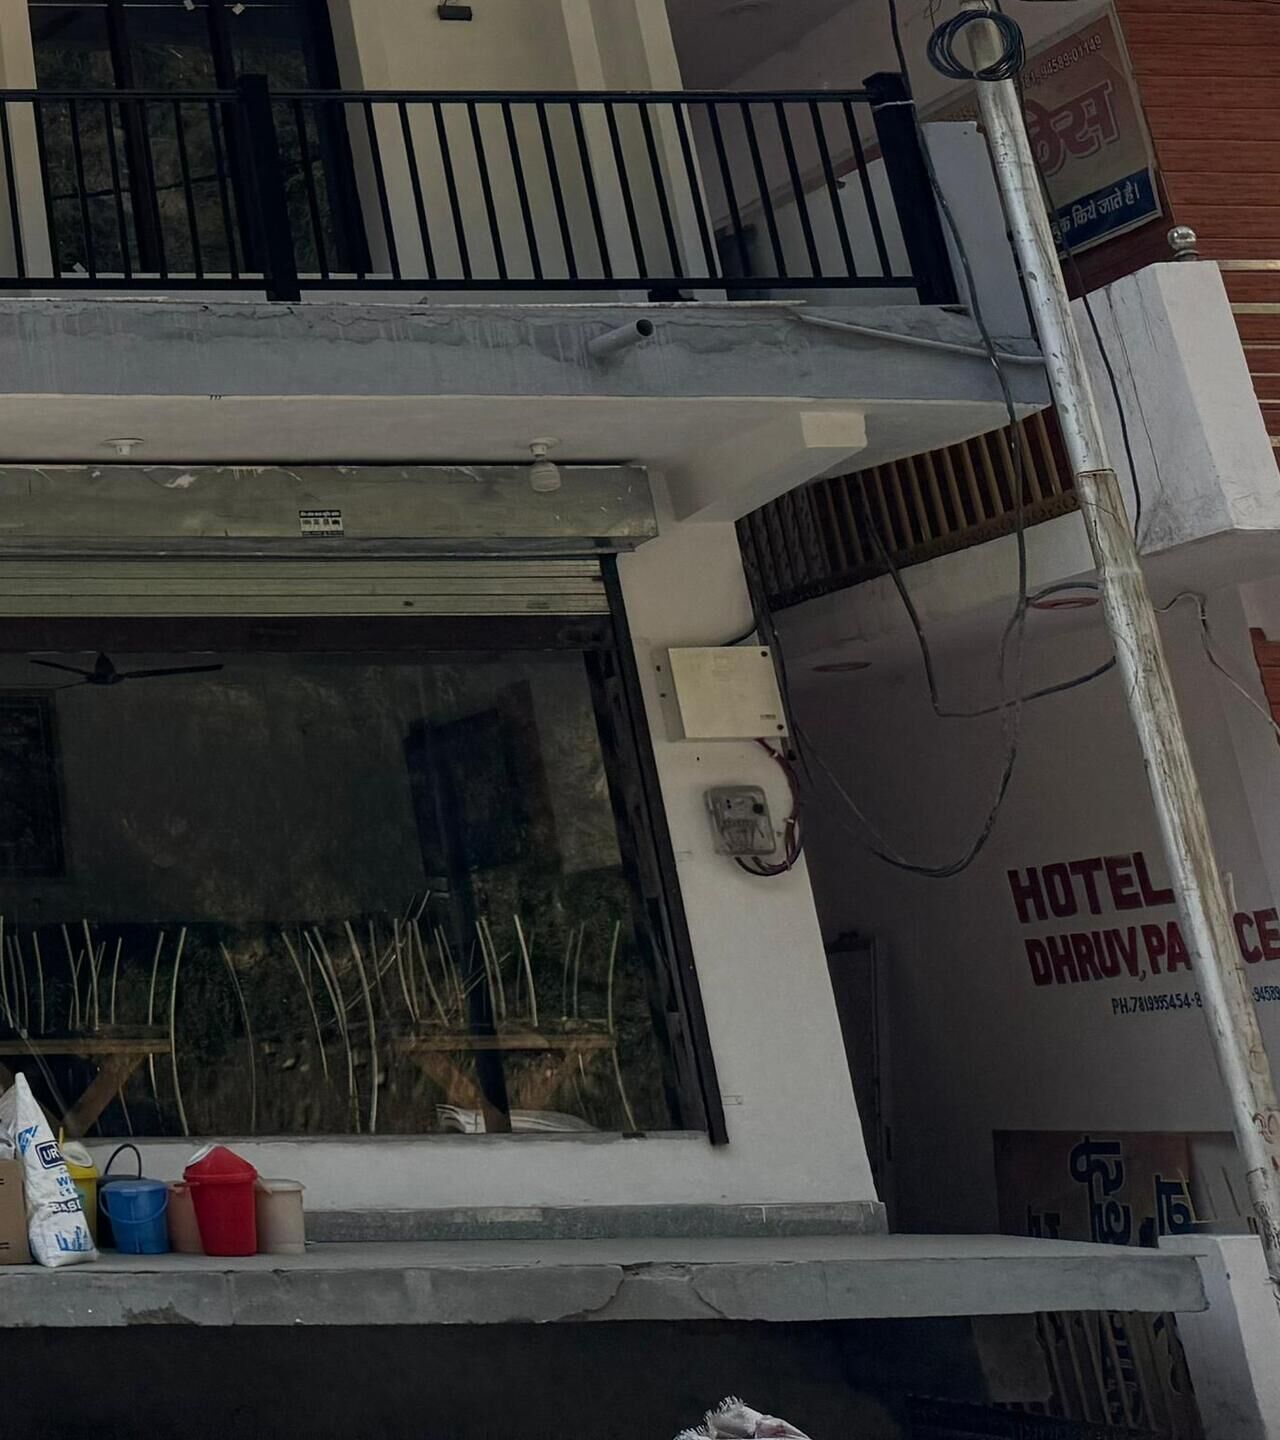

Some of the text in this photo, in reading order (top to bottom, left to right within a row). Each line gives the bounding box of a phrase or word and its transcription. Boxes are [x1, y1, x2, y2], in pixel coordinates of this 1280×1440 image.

[1097, 188, 1123, 214] जाते
[1008, 852, 1176, 923] HOTEL
[1141, 908, 1280, 974] PACE
